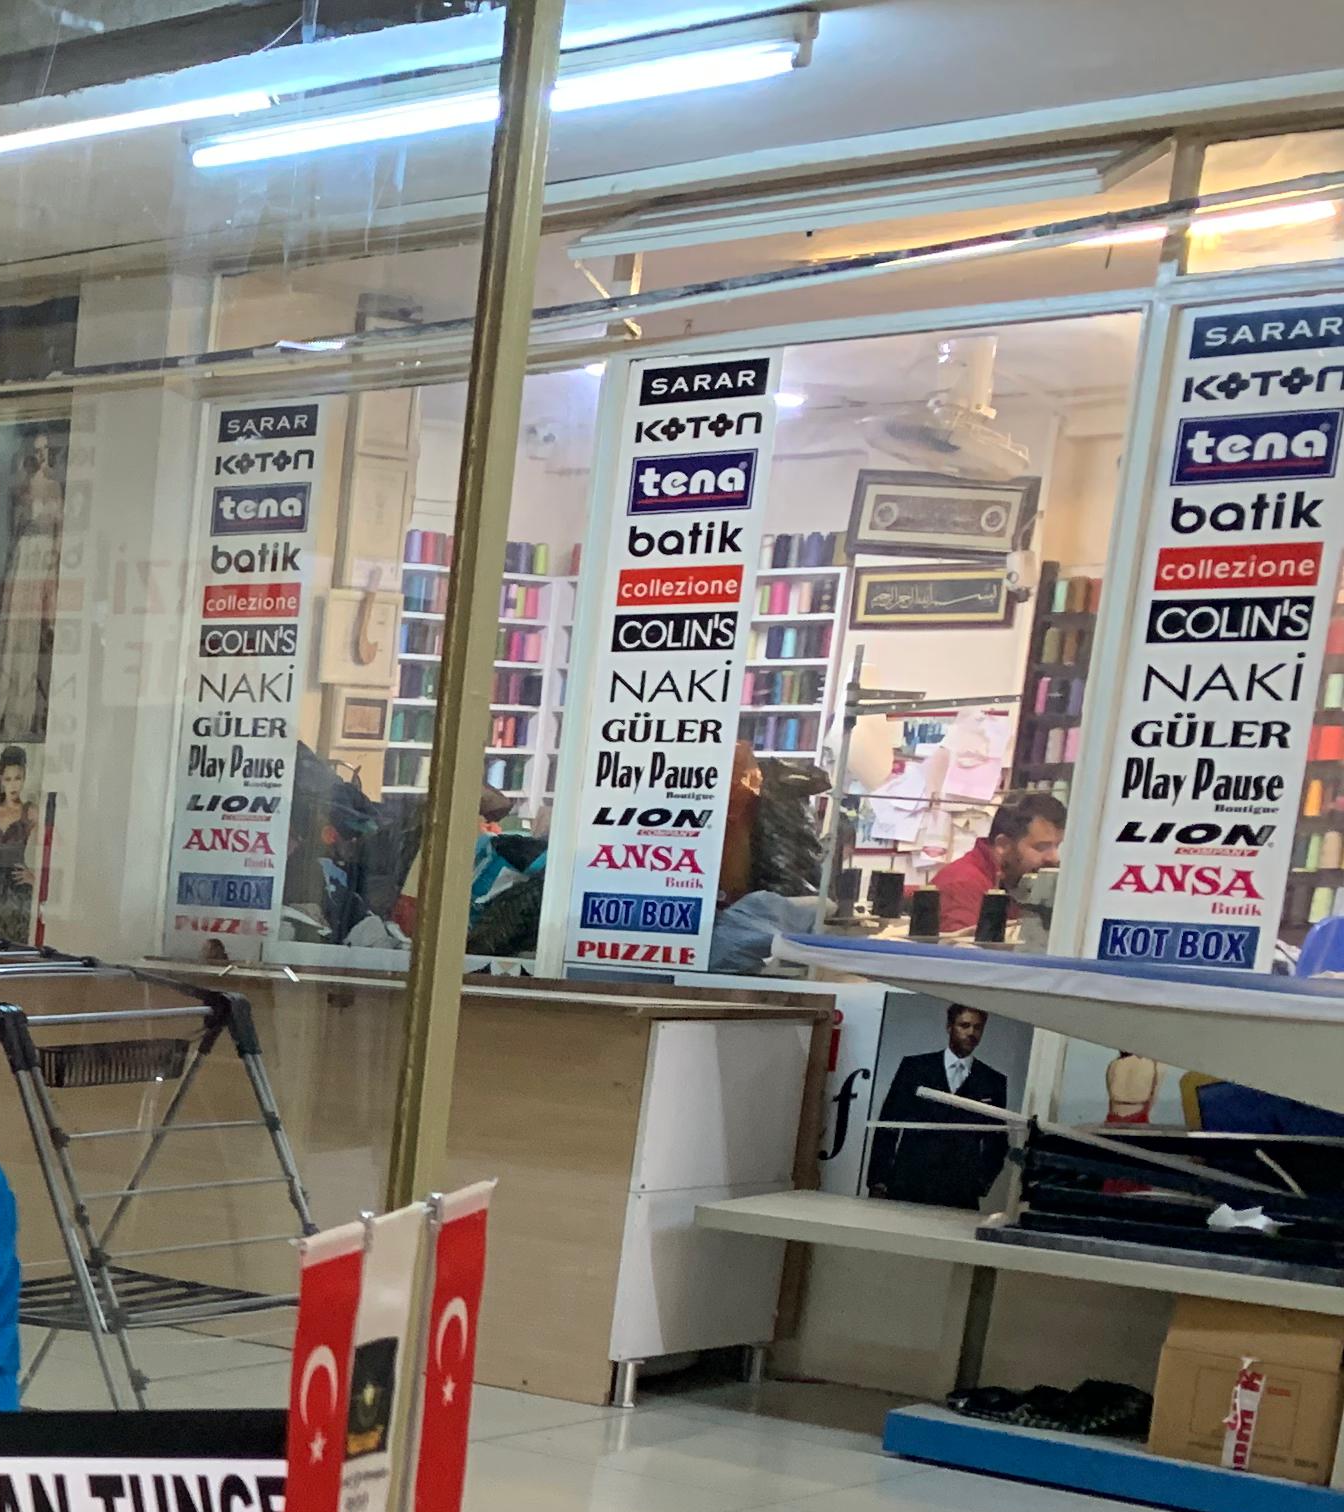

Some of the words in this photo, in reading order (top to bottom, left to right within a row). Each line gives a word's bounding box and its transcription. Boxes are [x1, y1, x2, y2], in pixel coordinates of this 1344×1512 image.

[1204, 317, 1343, 347] SARAR
[651, 370, 755, 395] SARAR
[227, 414, 308, 434] SARAR
[635, 412, 762, 443] KOTON
[1186, 430, 1328, 464] tena
[638, 467, 746, 497] tena
[219, 496, 303, 520] tena
[1171, 491, 1324, 534] batik
[628, 521, 743, 557] batik
[211, 542, 302, 574] batik
[1161, 554, 1315, 580] collezione
[621, 576, 738, 598] collezione
[206, 594, 297, 612] collezione
[618, 613, 735, 649] COLIN'S
[1155, 599, 1310, 640] COLIN'S
[205, 626, 296, 654] COLIN'S
[198, 664, 295, 703] NAKİ
[609, 660, 732, 703] NAKİ
[1142, 651, 1306, 702] NAKİ
[192, 711, 288, 738] GÜLER
[601, 712, 723, 743] GÜLER
[1131, 712, 1291, 749] GÜLER
[188, 744, 227, 783] Play
[229, 744, 285, 779] Pause
[595, 751, 645, 794] Play
[648, 751, 718, 789] Pause
[1121, 757, 1187, 807] Play
[1192, 757, 1285, 802] Pause
[186, 794, 281, 814] LION
[592, 807, 713, 828] LION
[182, 828, 276, 855] ANSA
[1115, 821, 1277, 847] LION
[587, 844, 705, 875] ANSA
[225, 880, 267, 904] BOX
[665, 877, 703, 889] Butik
[1109, 864, 1265, 900] ANSA
[587, 897, 635, 925] KOT
[640, 901, 694, 930] BOX
[1211, 902, 1262, 916] Butik
[577, 940, 697, 965] PUZZLE
[1108, 925, 1171, 959] KOT
[1177, 928, 1250, 963] BOX
